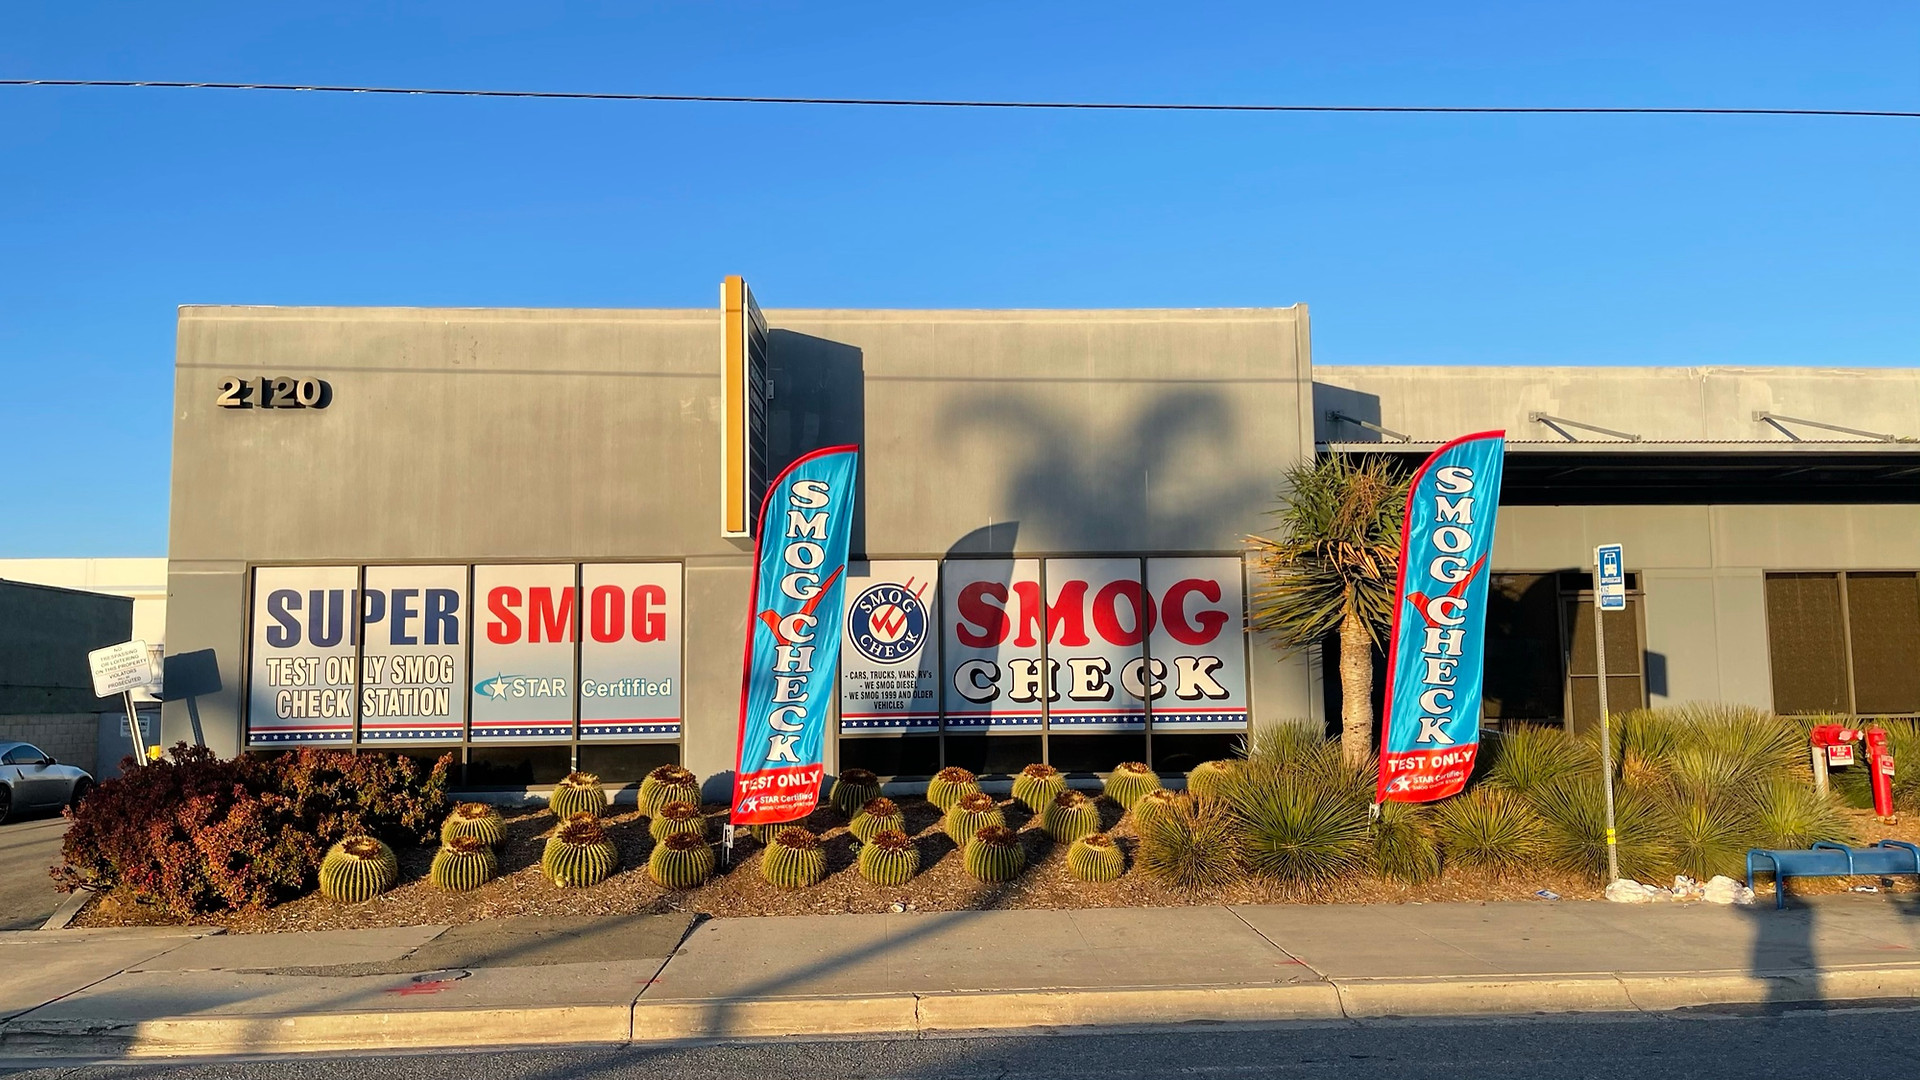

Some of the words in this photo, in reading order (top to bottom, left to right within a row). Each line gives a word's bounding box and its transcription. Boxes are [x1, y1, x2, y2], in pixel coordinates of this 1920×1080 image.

[216, 375, 321, 407] 2120
[1429, 466, 1475, 584] SMOG
[780, 479, 831, 601] SMOG
[487, 584, 667, 645] SMOG
[859, 589, 917, 614] SMOG
[956, 578, 1230, 649] SMOG
[266, 588, 460, 648] SUPER
[859, 629, 919, 658] CHECK
[107, 676, 142, 689] PROSECUTED
[109, 668, 137, 679] VIOLATORS
[266, 656, 320, 686] TEST
[325, 656, 386, 685] ONLY
[390, 655, 454, 684] SMOG
[850, 671, 869, 681] CARS,
[870, 671, 897, 681] TRUCKS,
[898, 670, 917, 680] VANS,
[953, 655, 1231, 704] CHECK
[1416, 595, 1469, 745] CHECK
[512, 677, 568, 698] STAR
[581, 678, 672, 698] Certified
[765, 612, 819, 763] CHECK
[849, 691, 859, 700] WE
[860, 691, 880, 700] SMOG
[881, 690, 897, 699] 1999
[898, 690, 912, 699] AND
[913, 690, 934, 699] OLDER
[864, 681, 875, 690] WE
[875, 681, 895, 690] SMOG
[896, 680, 918, 689] DIESEL
[276, 688, 352, 719] CHECK
[362, 687, 450, 717] STATION
[873, 700, 905, 710] VEHICLES
[1388, 756, 1426, 773] TEST
[1431, 750, 1473, 769] ONLY
[739, 775, 775, 793] TEST
[777, 769, 820, 787] ONLY
[1413, 775, 1434, 785] STAR
[1435, 770, 1464, 782] Certified
[760, 795, 779, 804] STAR
[780, 792, 813, 803] Certified
